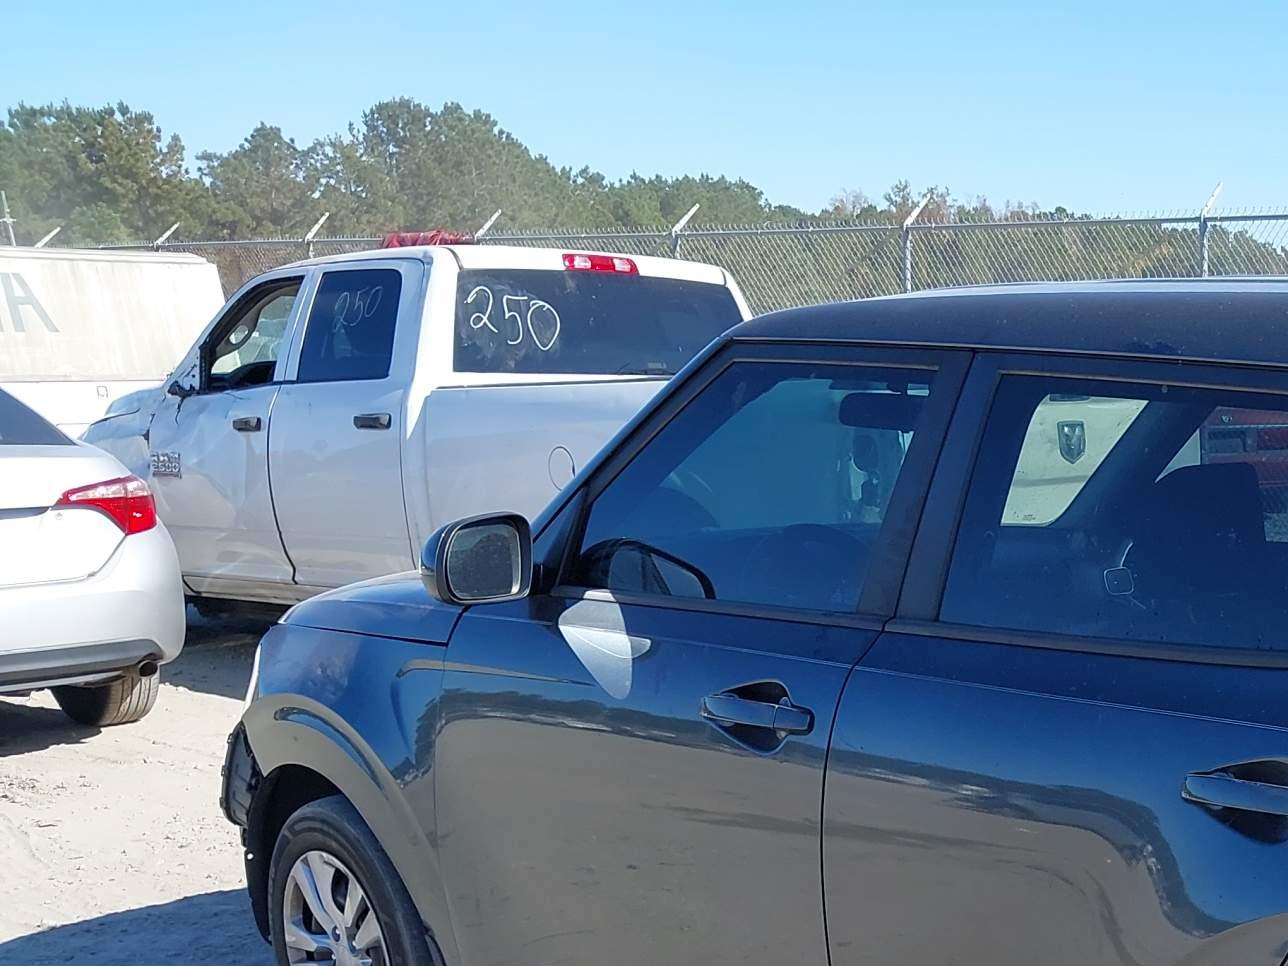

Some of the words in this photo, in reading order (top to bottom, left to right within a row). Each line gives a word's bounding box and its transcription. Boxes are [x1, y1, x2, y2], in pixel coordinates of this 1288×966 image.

[0, 272, 60, 332] A
[333, 285, 384, 333] 250
[463, 285, 561, 351] 250
[151, 461, 180, 473] 2500
